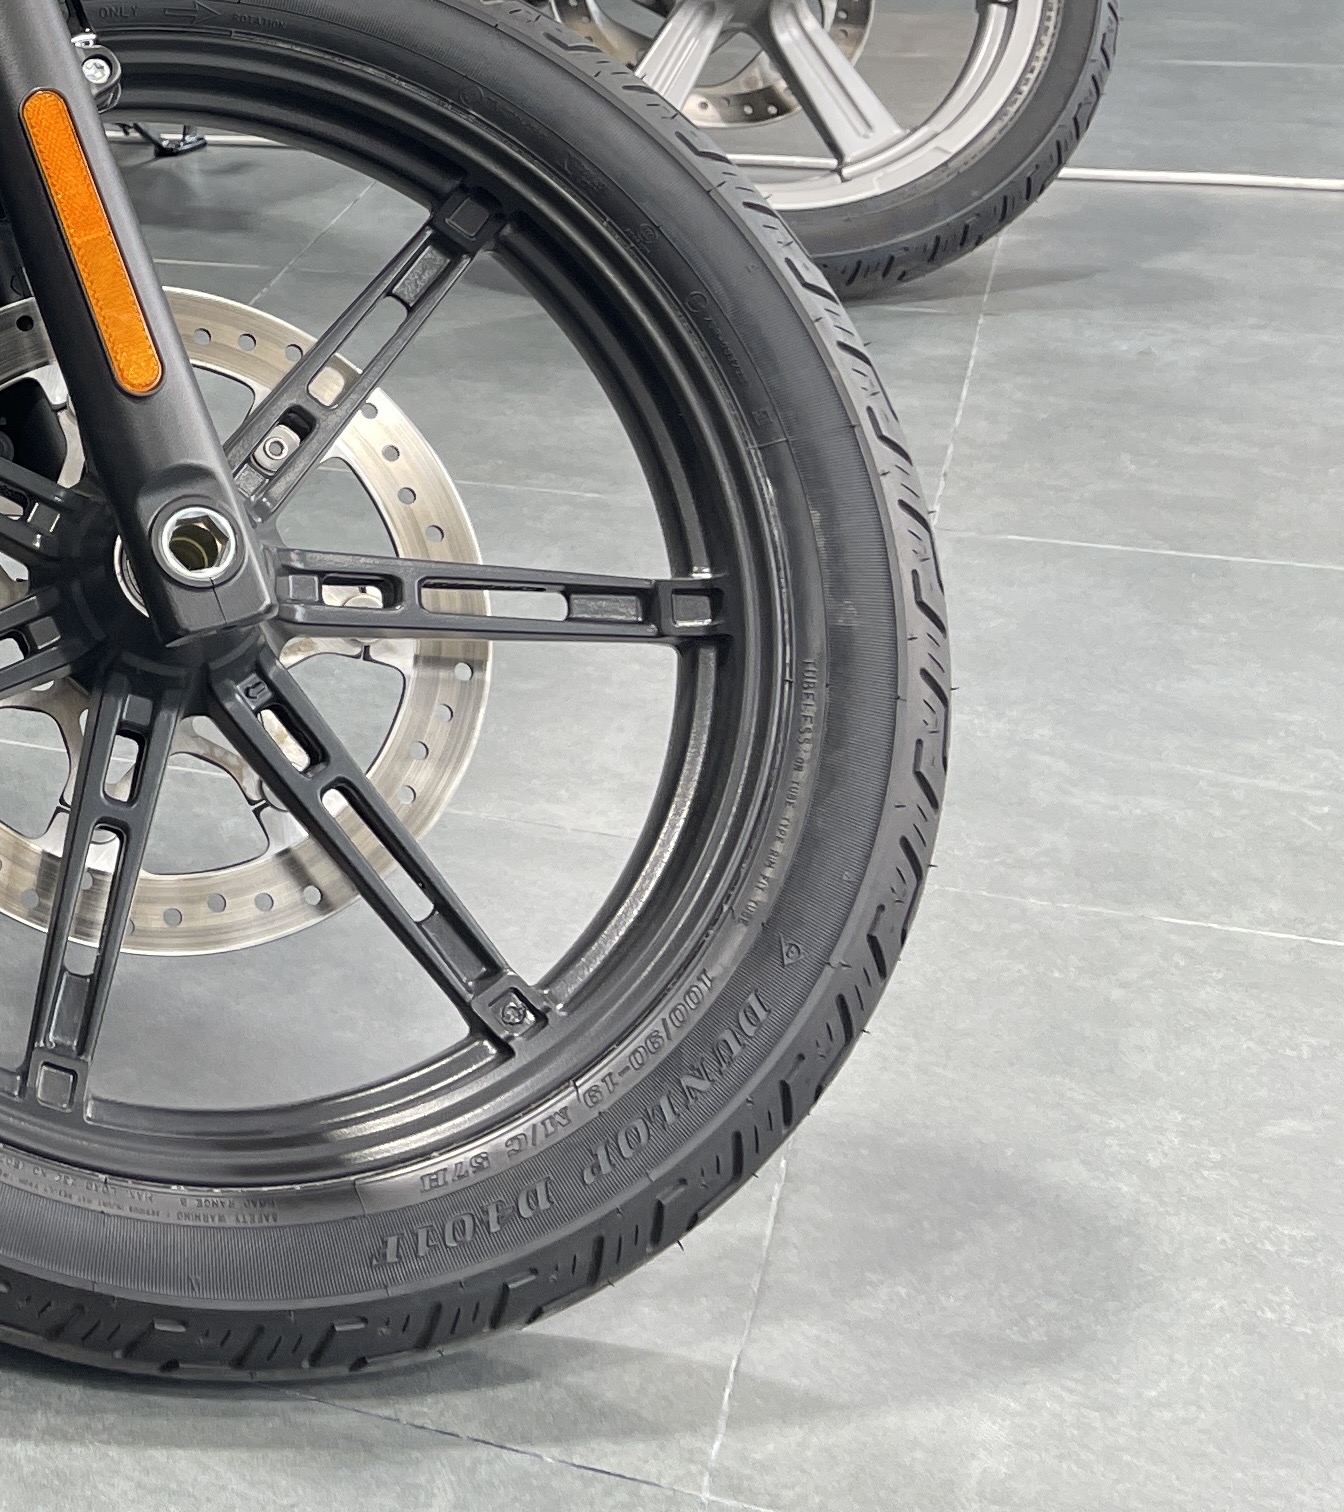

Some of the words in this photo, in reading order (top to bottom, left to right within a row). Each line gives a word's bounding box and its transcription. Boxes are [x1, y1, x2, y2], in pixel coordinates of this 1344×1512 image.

[98, 5, 139, 19] ONLY
[570, 985, 778, 1187] DUNLOP
[500, 1103, 577, 1159] M/C
[414, 1149, 495, 1194] 57H
[175, 1210, 227, 1223] WARNING
[234, 1212, 279, 1224] SAFETY
[364, 1174, 563, 1269] D401F
